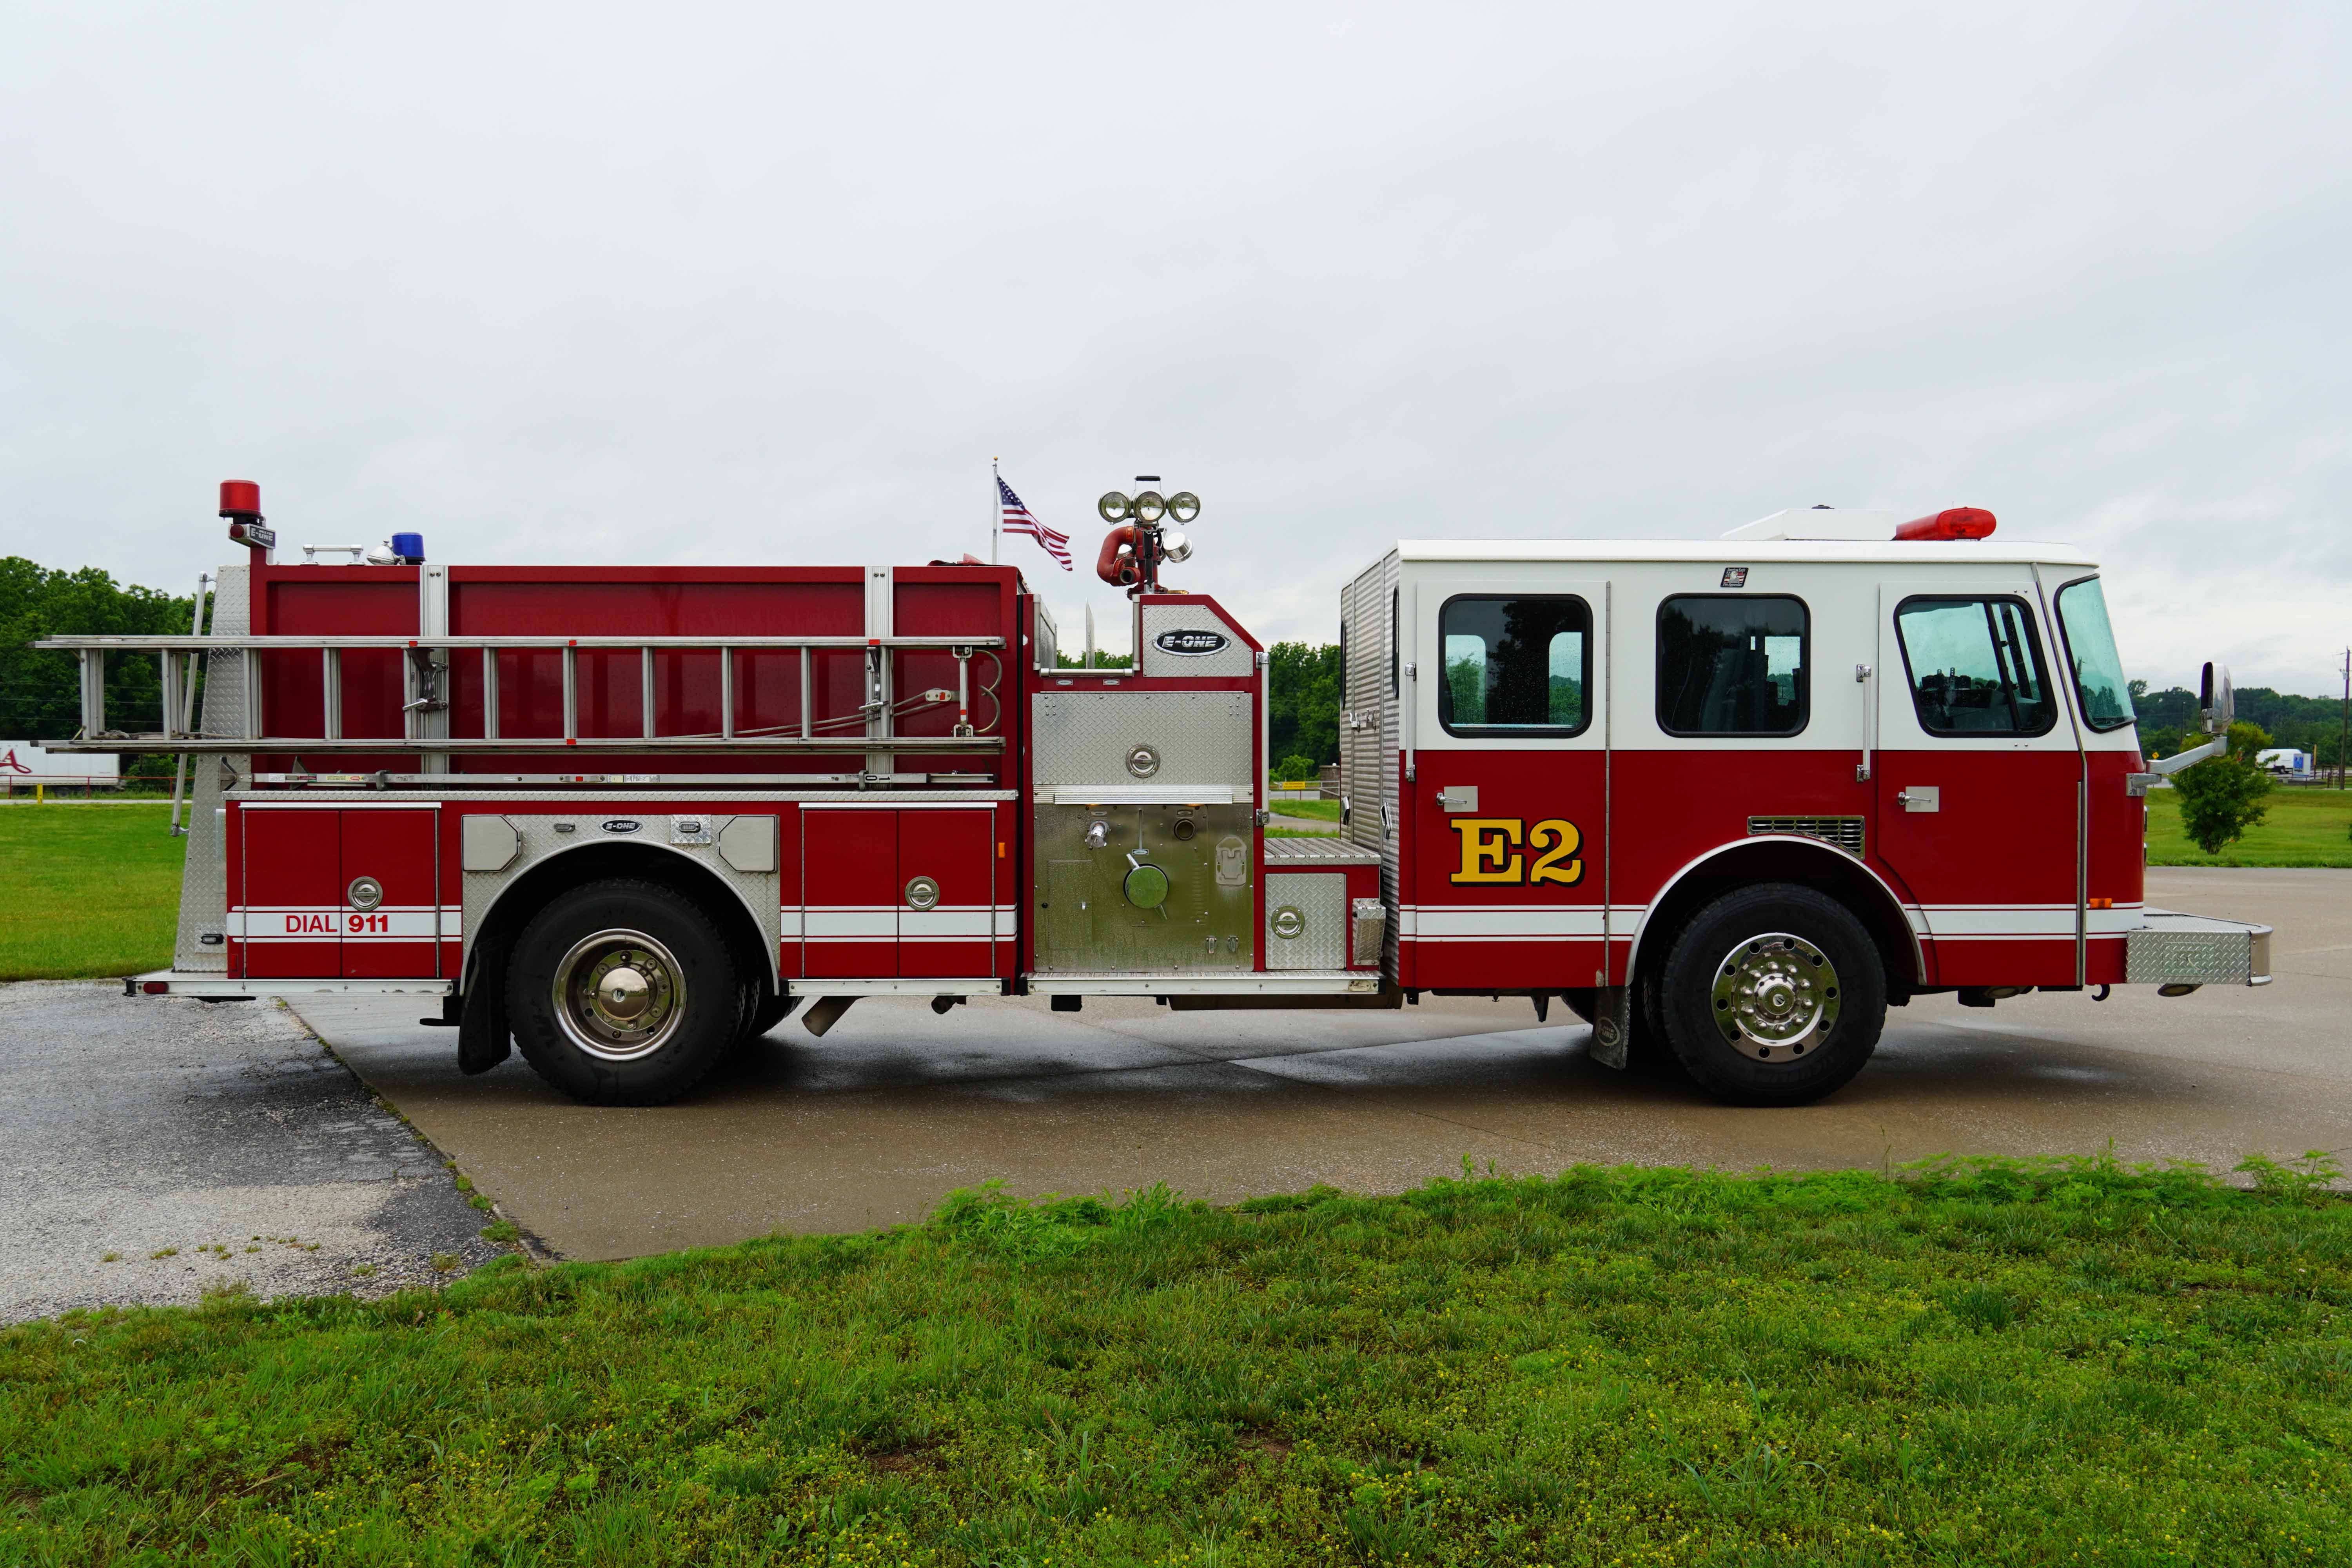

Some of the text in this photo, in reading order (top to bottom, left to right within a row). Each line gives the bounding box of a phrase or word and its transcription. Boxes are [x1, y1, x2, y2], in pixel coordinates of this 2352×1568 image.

[251, 528, 273, 541] E-ONE
[1162, 635, 1218, 648] E-ONE
[1450, 818, 1584, 887] E2
[286, 915, 388, 933] DIAL 911
